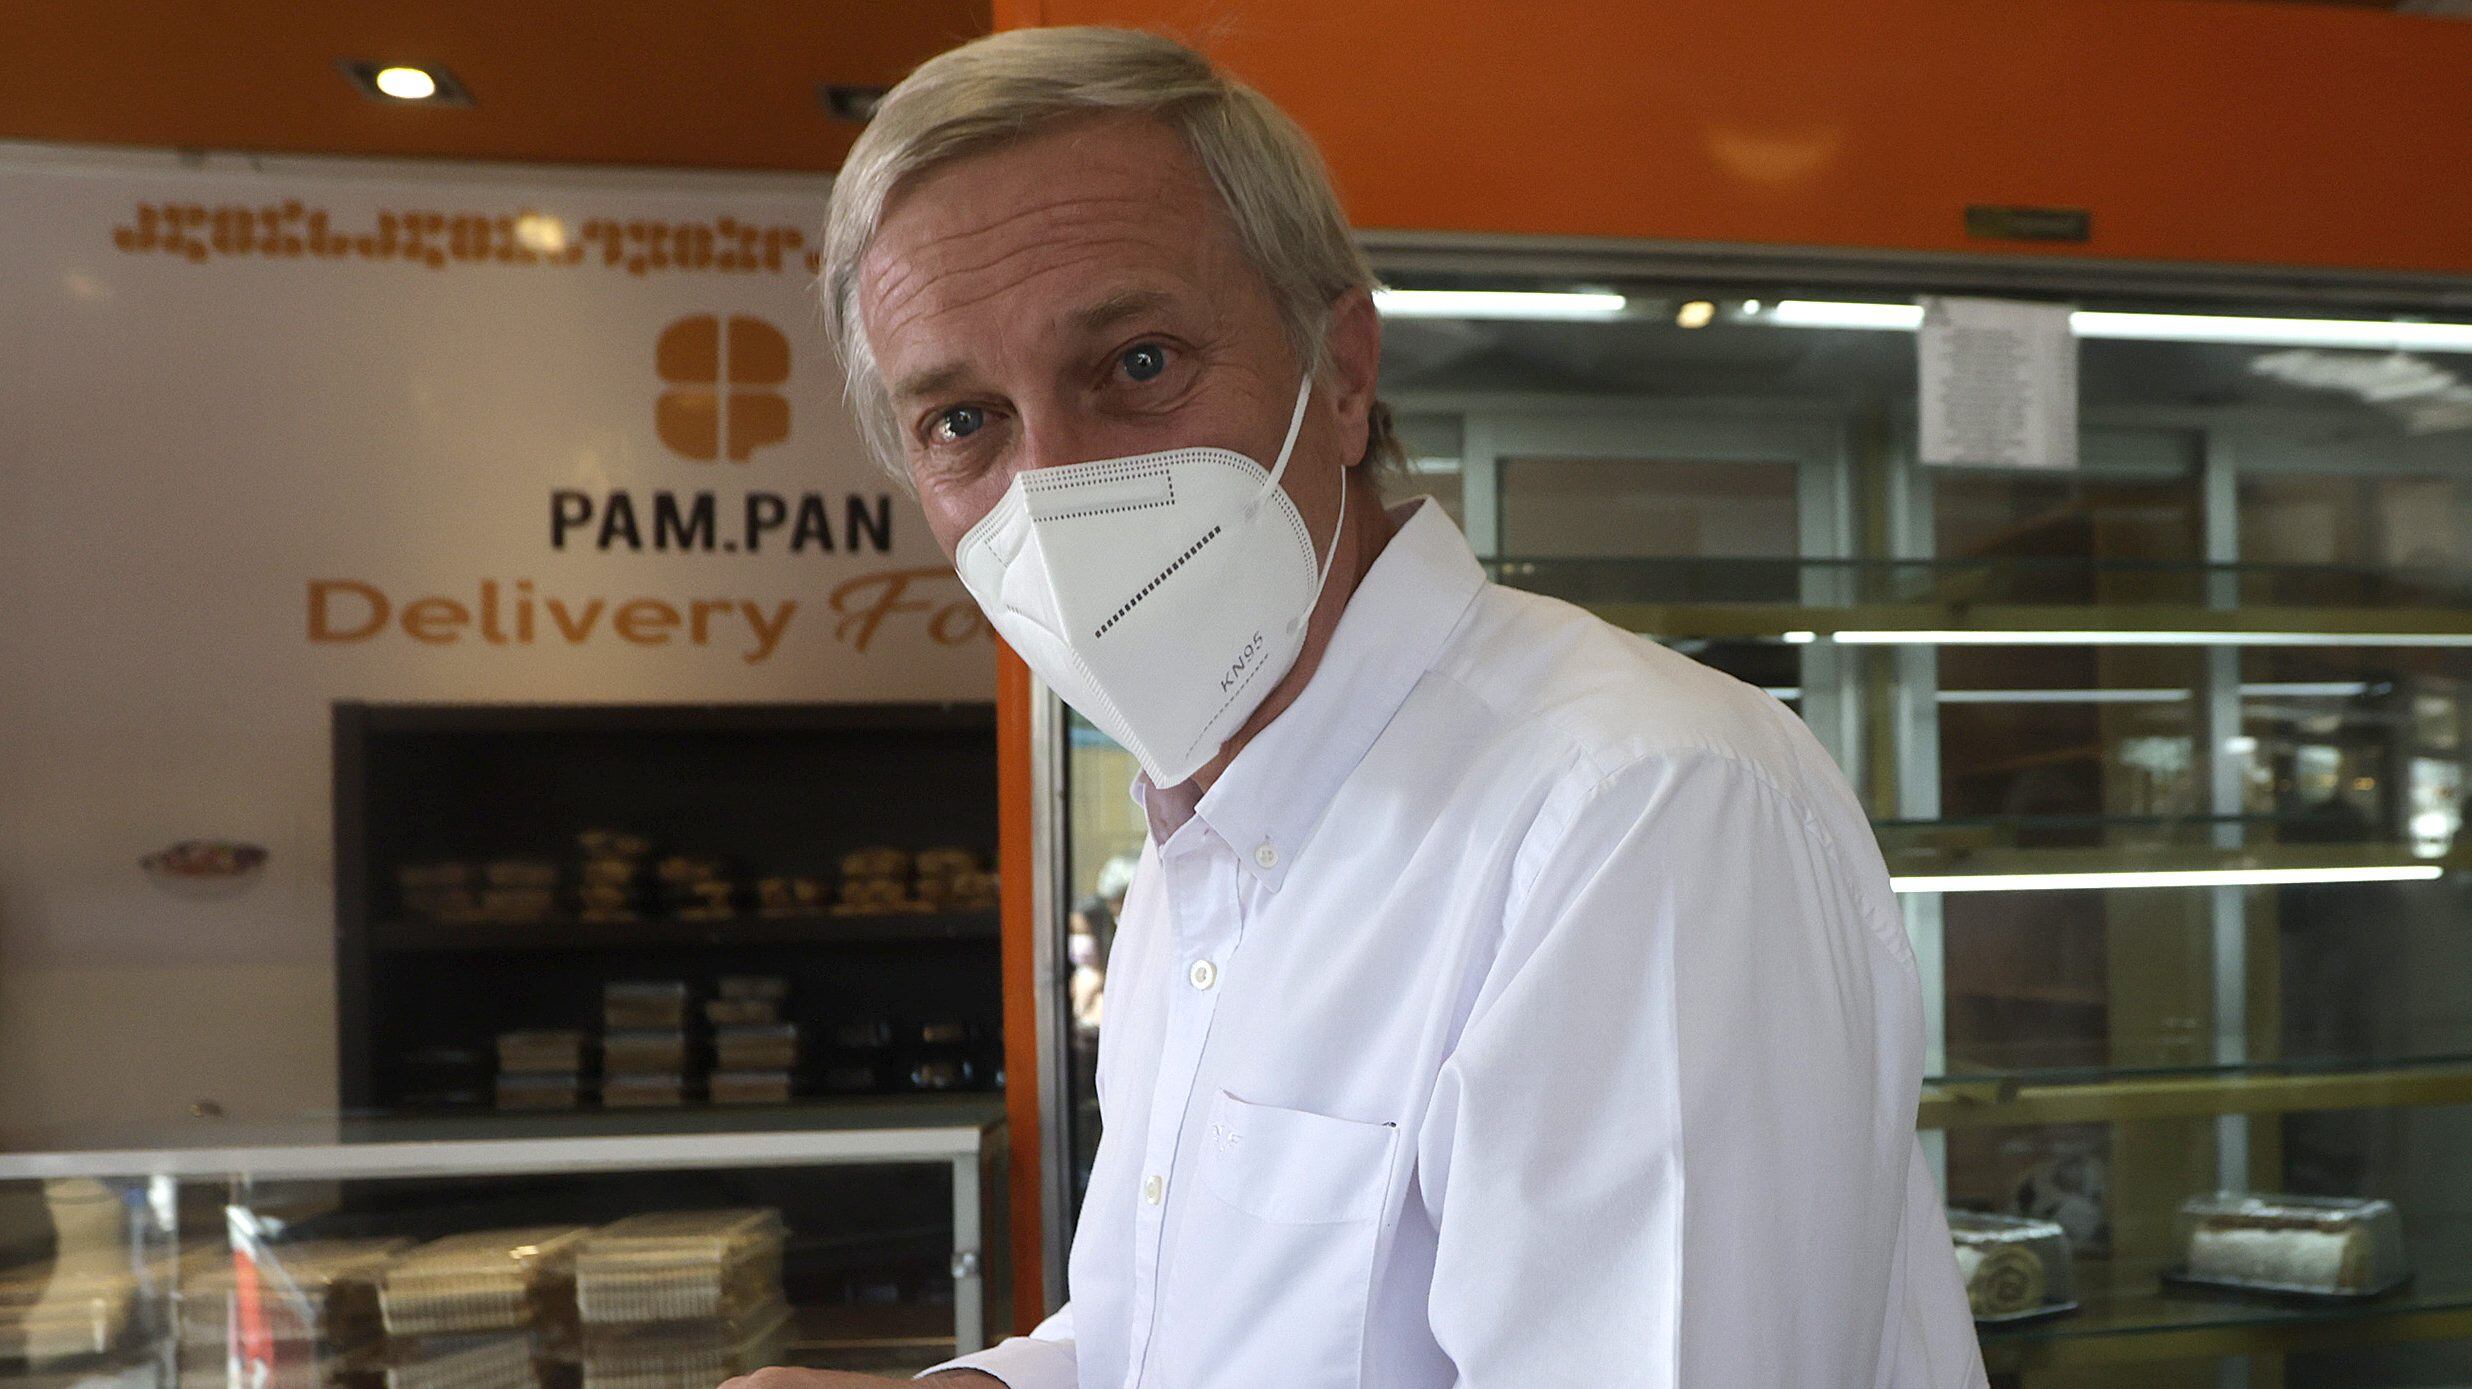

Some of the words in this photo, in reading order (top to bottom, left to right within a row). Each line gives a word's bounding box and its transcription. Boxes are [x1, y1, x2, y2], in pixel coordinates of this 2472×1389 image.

[550, 489, 893, 555] PAM.PAN
[307, 578, 797, 666] Delivery
[829, 565, 997, 655] Fo
[1220, 630, 1264, 693] KN95
